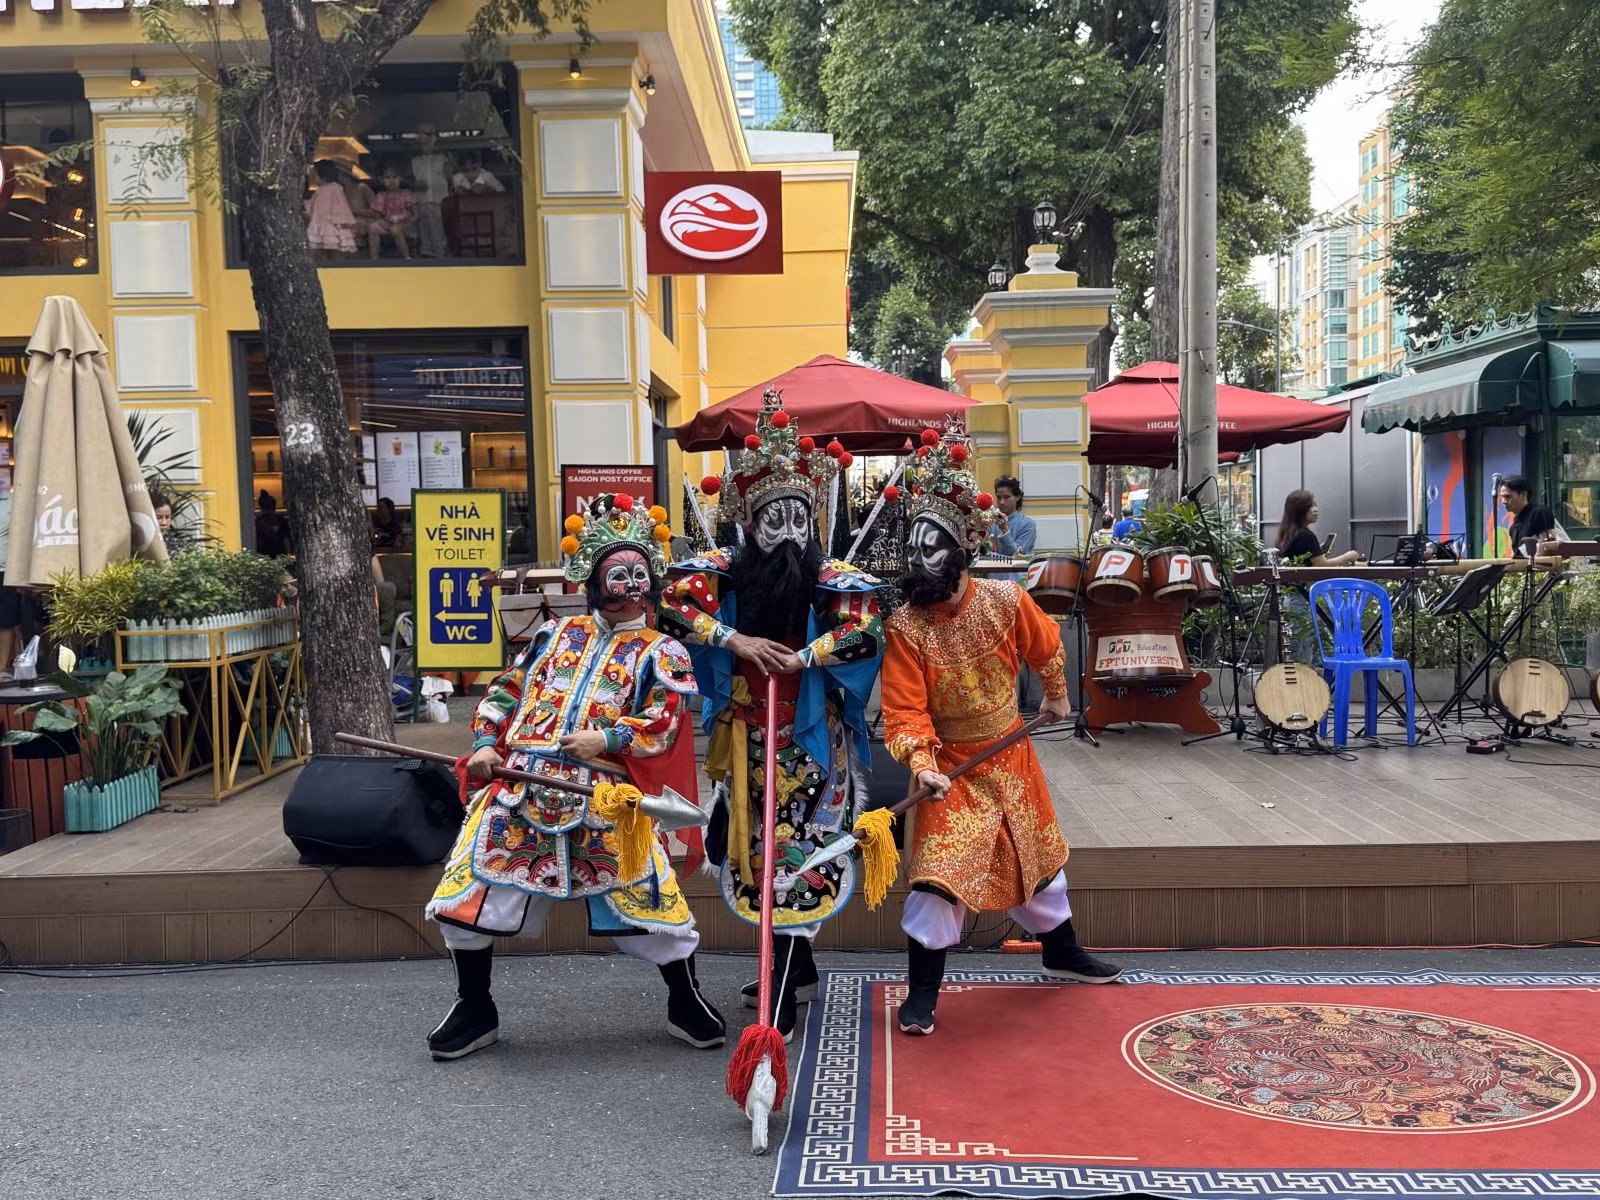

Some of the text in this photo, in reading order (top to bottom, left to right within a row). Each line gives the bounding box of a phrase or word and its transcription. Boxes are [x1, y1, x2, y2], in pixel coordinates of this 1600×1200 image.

[888, 417, 942, 428] HIGHLANDS
[285, 422, 315, 447] 23
[568, 475, 653, 483] SAIGON POST OFFICE
[440, 501, 480, 519] NHÀ
[425, 523, 495, 545] VỆ SINH
[435, 548, 486, 560] TOILET
[445, 625, 478, 640] WC
[1109, 639, 1168, 654] FPT Education
